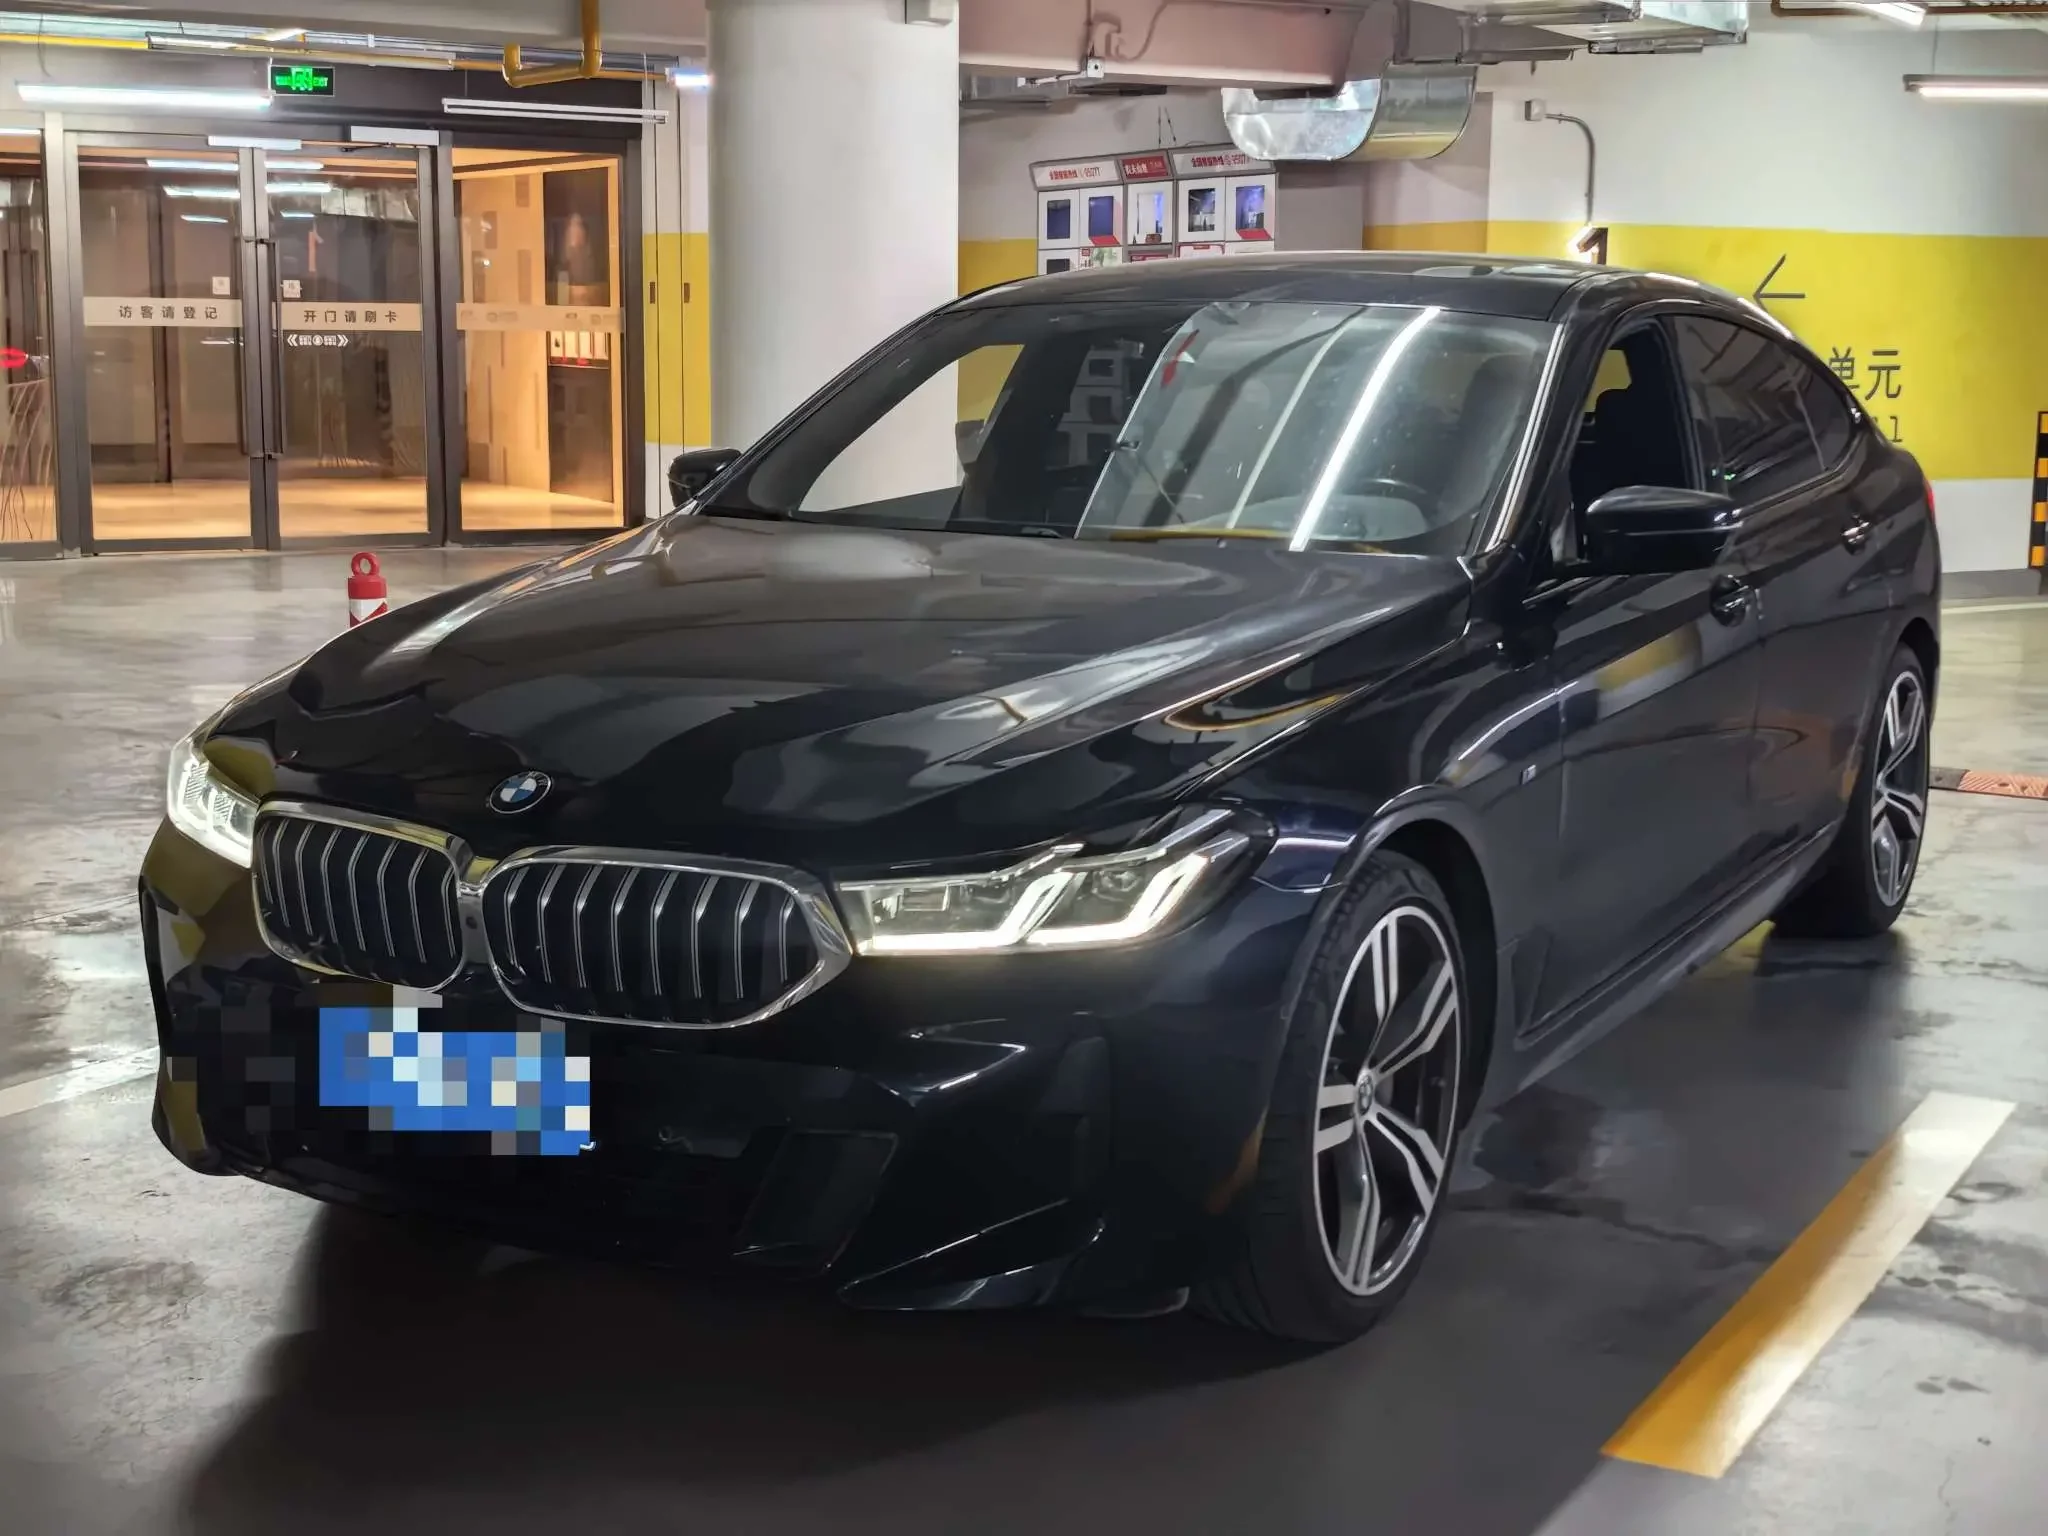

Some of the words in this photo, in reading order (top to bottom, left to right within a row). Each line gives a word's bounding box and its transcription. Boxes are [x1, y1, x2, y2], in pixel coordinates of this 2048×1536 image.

[119, 304, 219, 321] 访客请登记
[303, 309, 398, 324] 开门请刷卡
[1828, 346, 1902, 401] 单元
